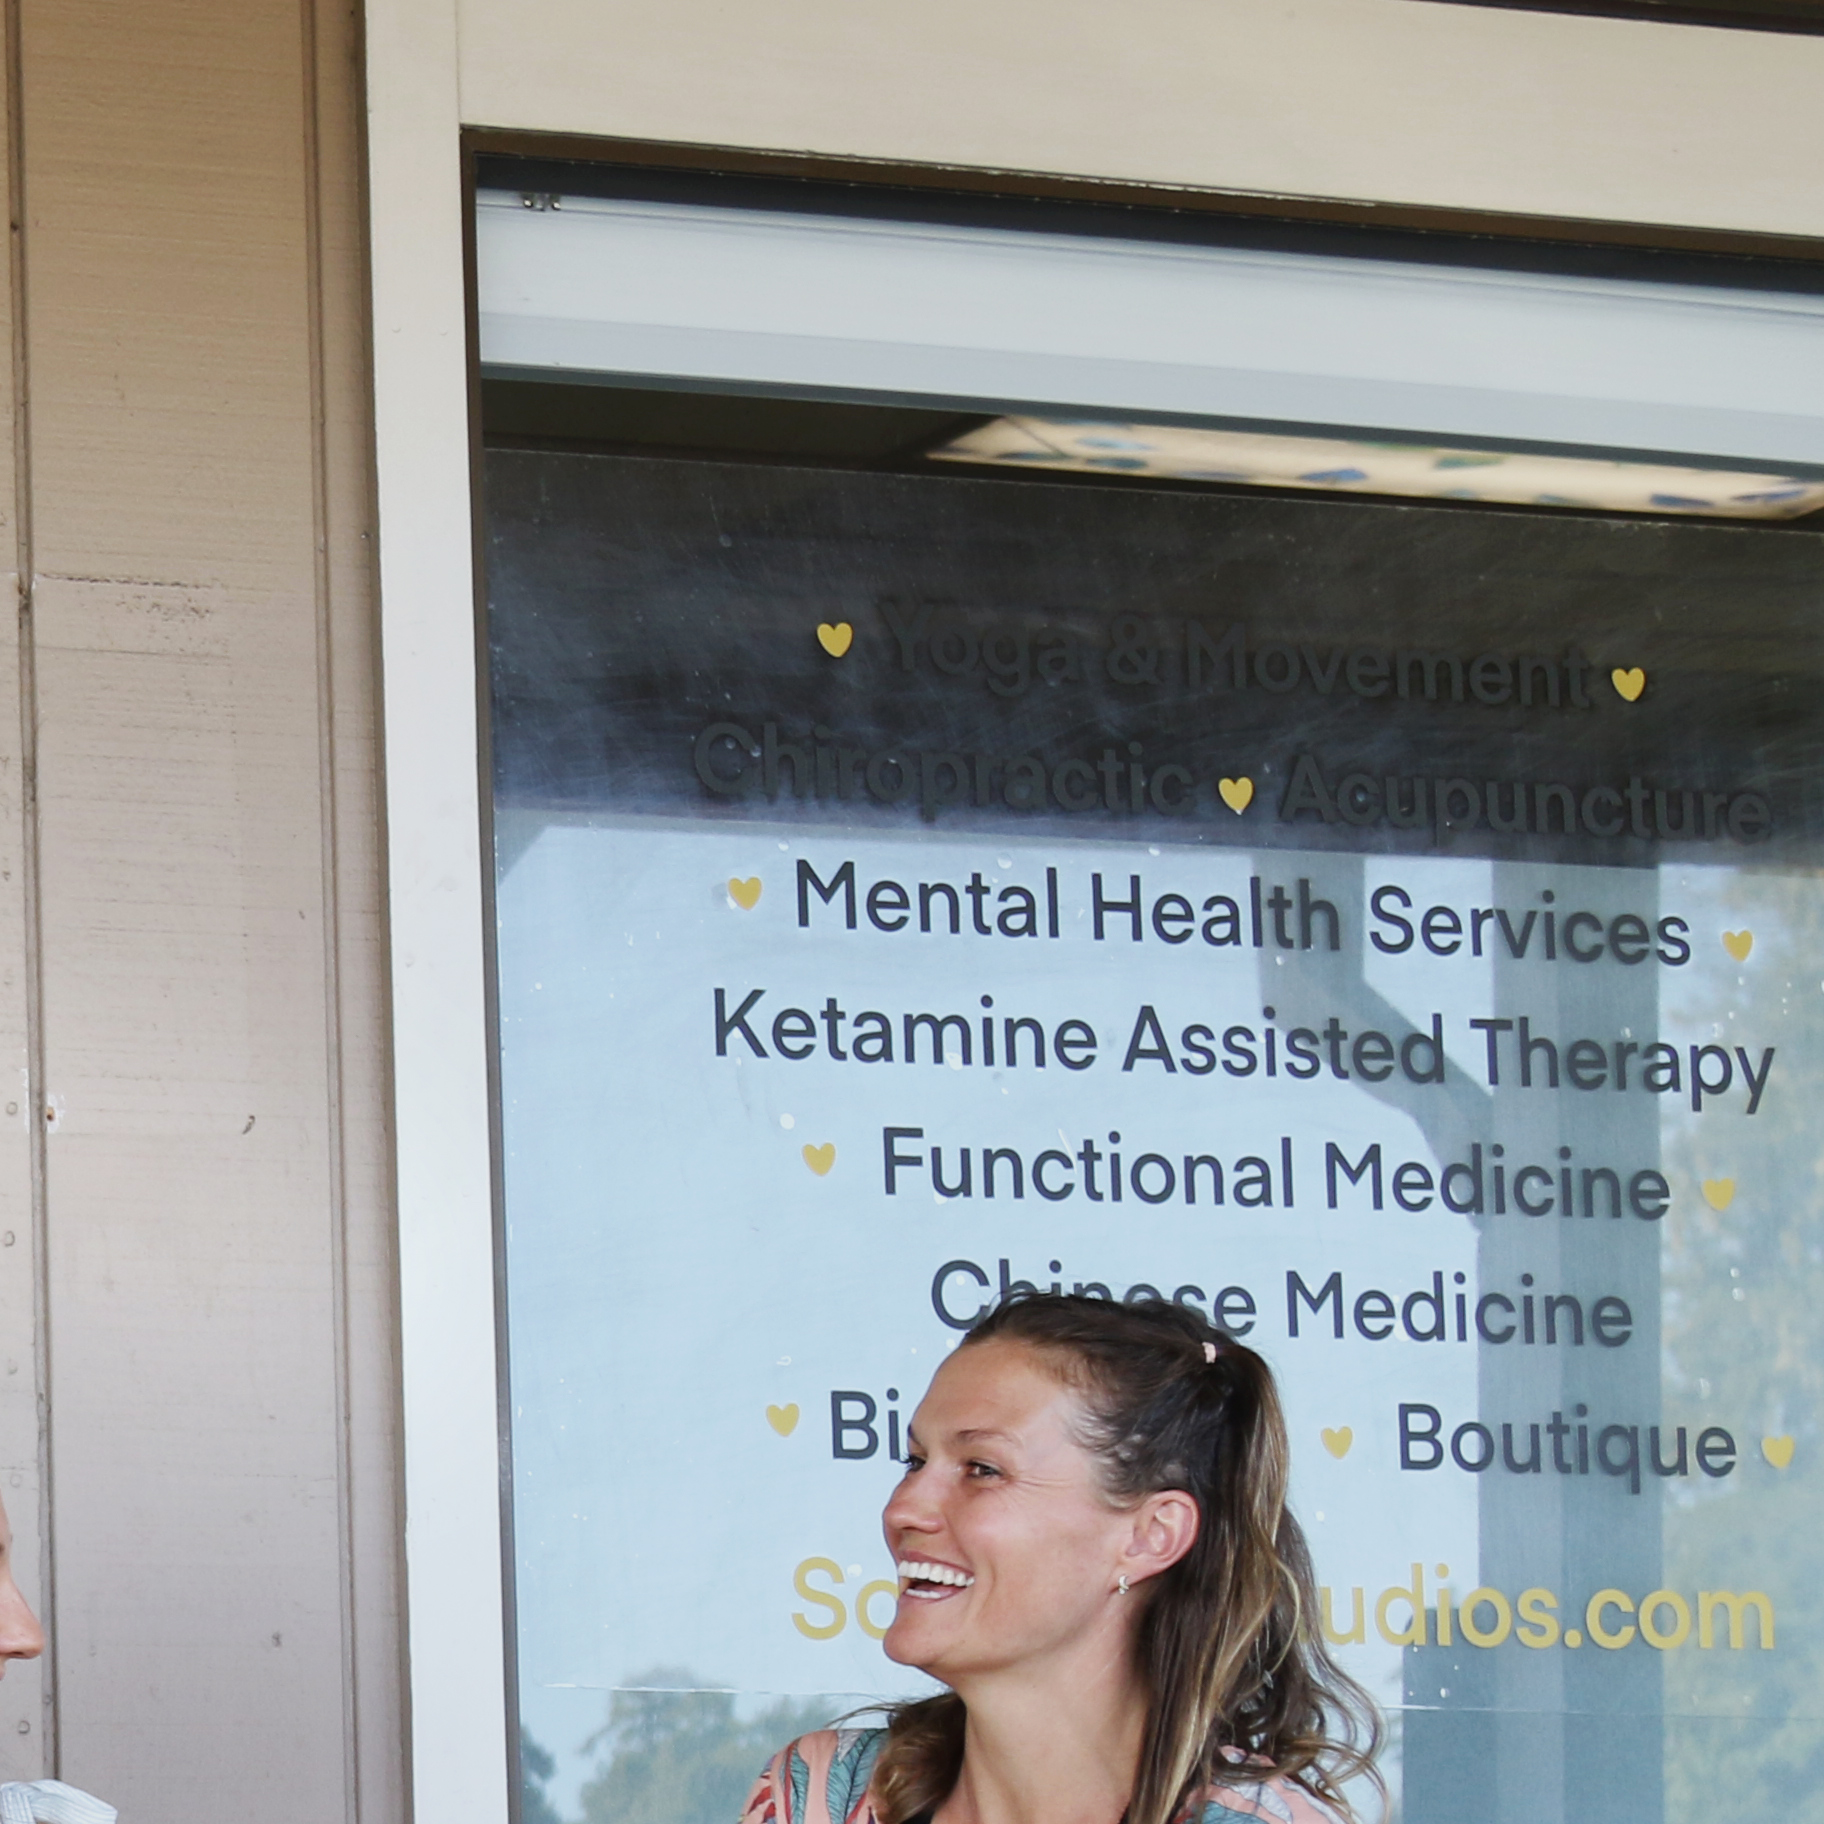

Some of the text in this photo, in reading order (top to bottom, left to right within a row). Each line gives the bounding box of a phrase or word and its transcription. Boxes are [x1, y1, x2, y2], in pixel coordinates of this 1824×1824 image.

[877, 601, 1590, 707] Yoga & Movement
[693, 722, 1771, 848] Chiropractic Acupuncture
[796, 859, 1691, 967] Mental Health Services
[714, 988, 1776, 1115] Ketamine Assisted Therapy
[883, 1126, 1670, 1222] Functional Medicine
[1286, 1270, 1633, 1349] Medicine
[1398, 1402, 1737, 1496] Boutique
